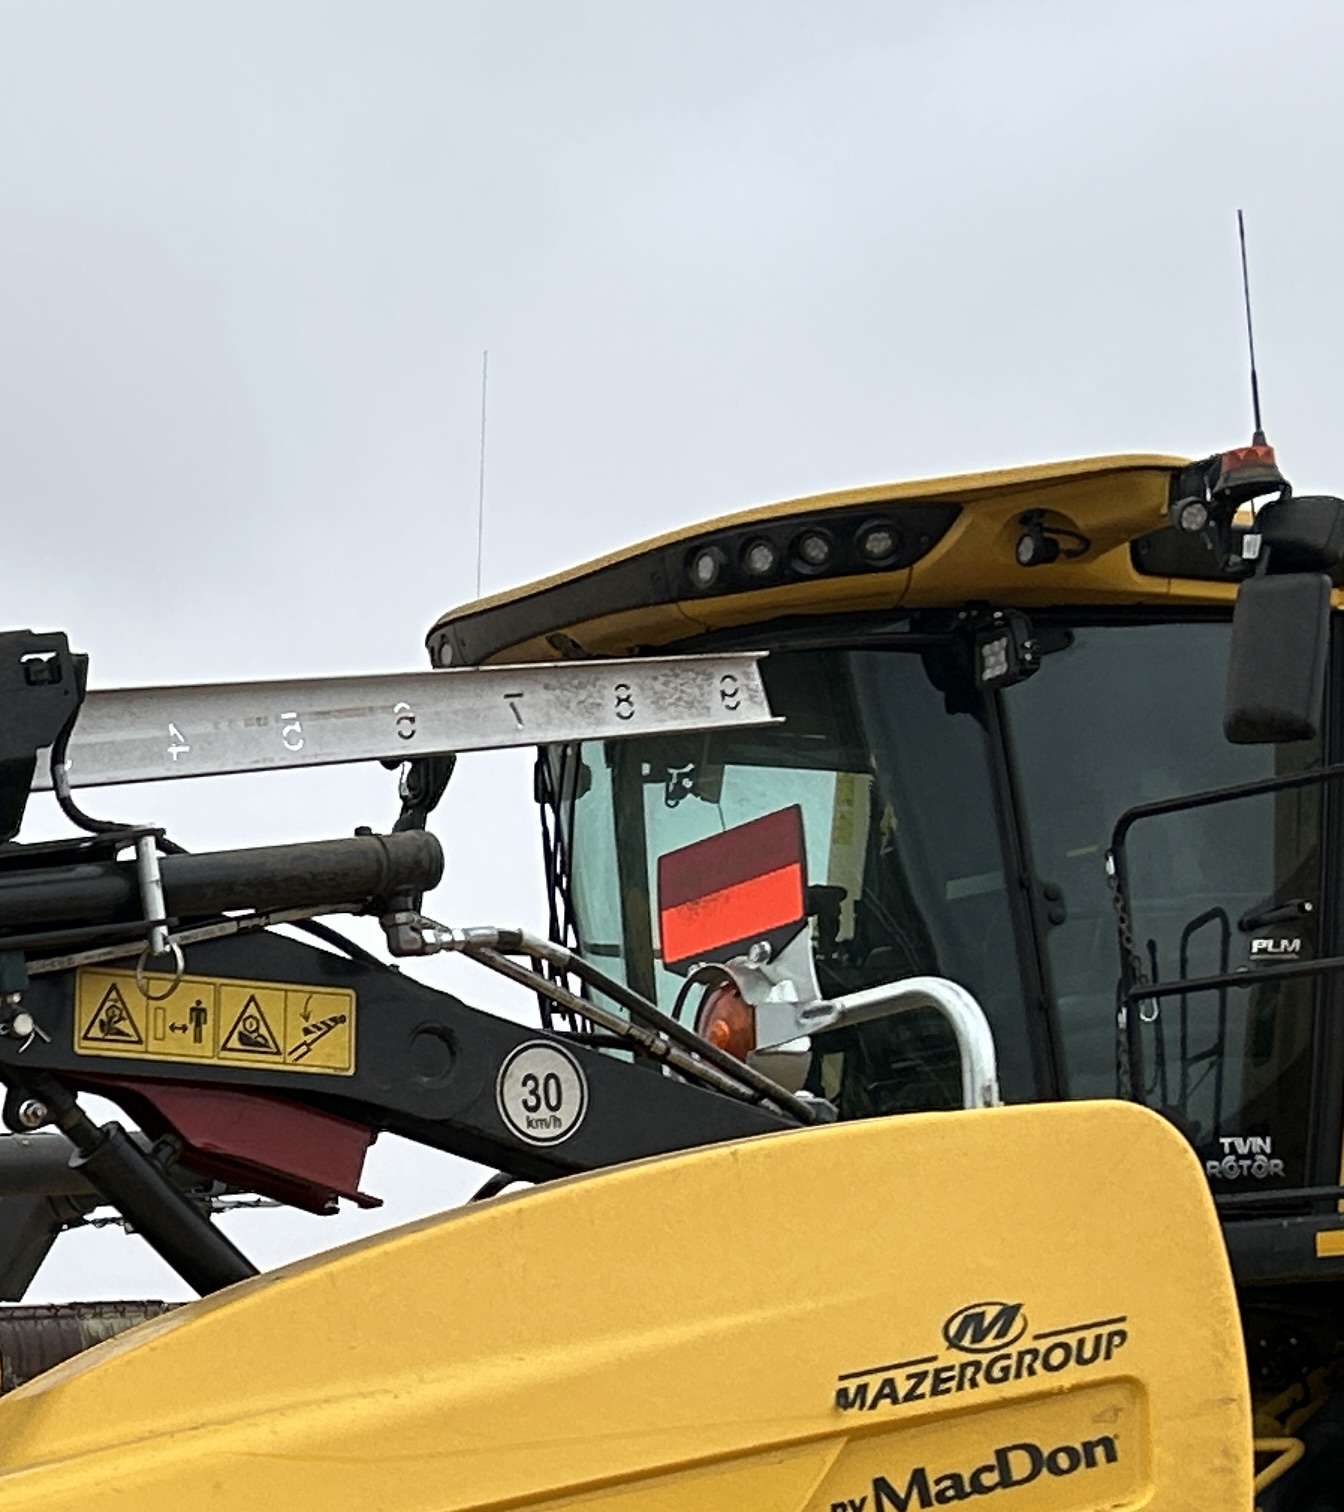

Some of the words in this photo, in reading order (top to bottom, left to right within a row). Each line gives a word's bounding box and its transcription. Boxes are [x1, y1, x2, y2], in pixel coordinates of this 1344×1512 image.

[167, 723, 191, 761] 4
[281, 712, 305, 751] 5
[503, 692, 524, 730] 7
[614, 683, 635, 720] 8
[720, 674, 741, 710] 9
[1250, 939, 1302, 953] PLM
[522, 1072, 563, 1114] 30
[526, 1115, 563, 1130] km/h
[1219, 1136, 1272, 1154] TWIN
[1205, 1155, 1286, 1179] ROTOR
[834, 1329, 1128, 1412] MAZERGROUP
